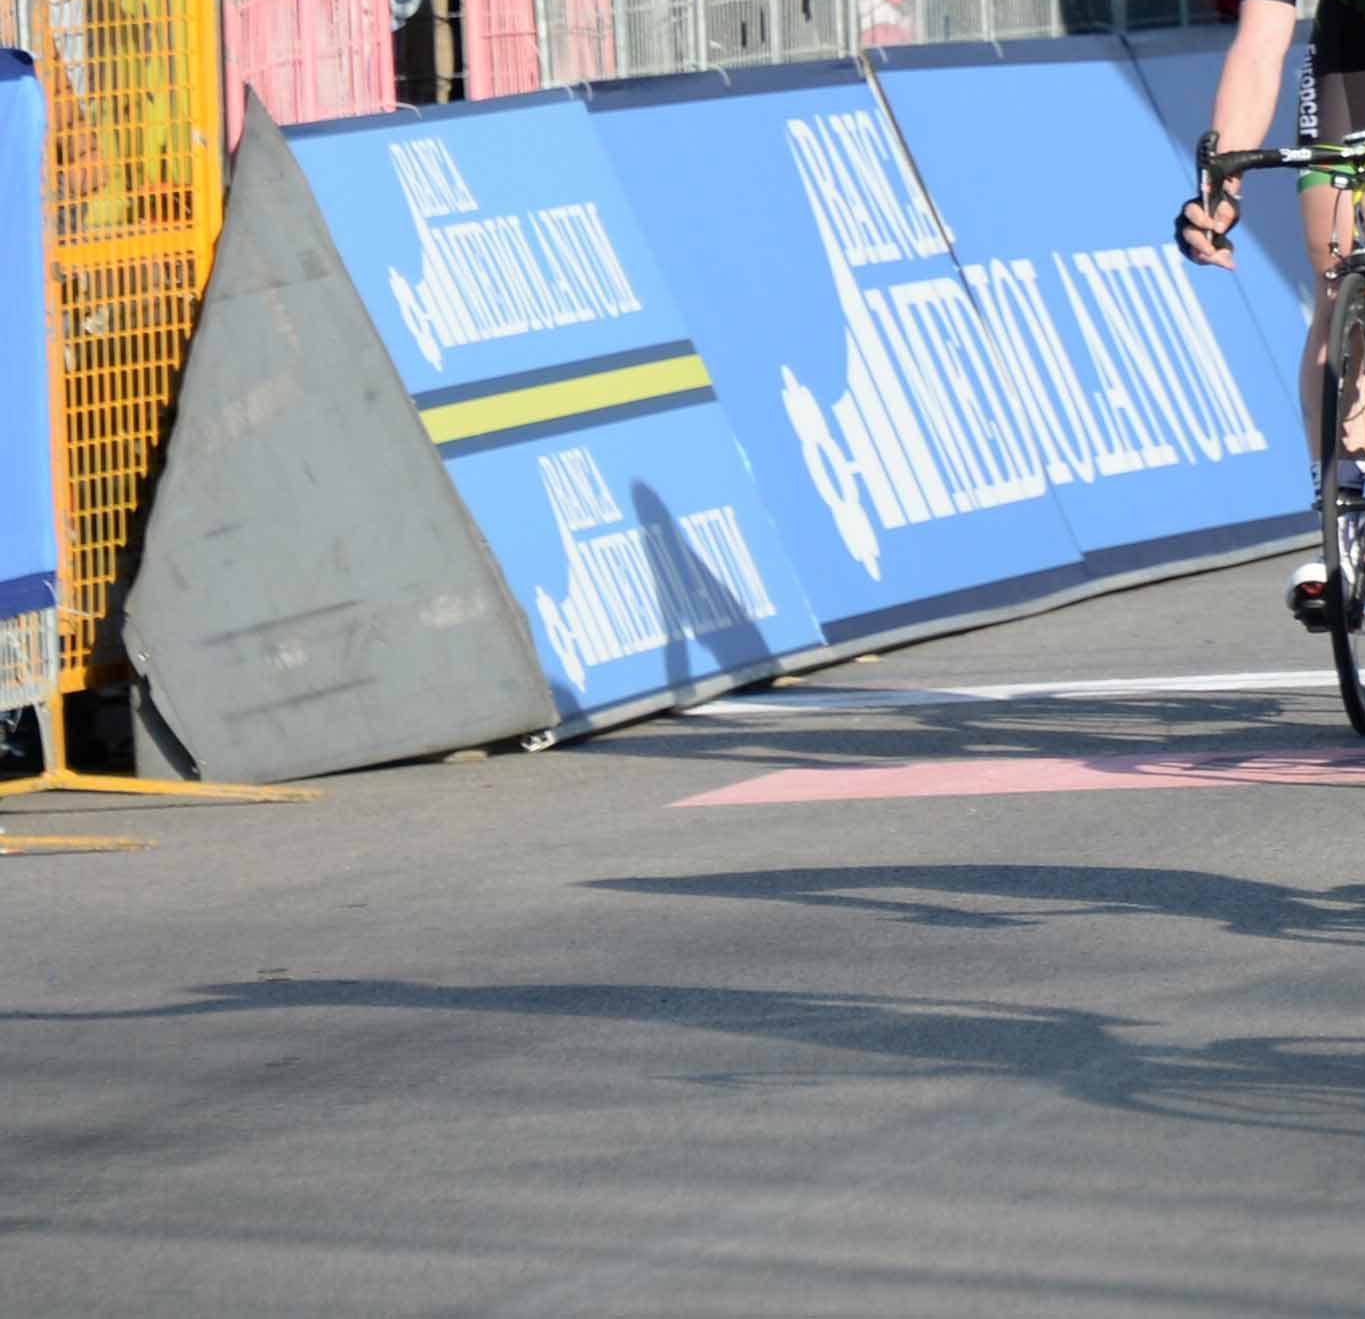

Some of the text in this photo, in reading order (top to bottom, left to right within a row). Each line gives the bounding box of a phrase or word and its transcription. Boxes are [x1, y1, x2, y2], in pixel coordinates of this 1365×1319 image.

[388, 137, 480, 222] BANCA
[788, 107, 958, 268] BANCA
[418, 200, 643, 350] MEDIOLANUM
[836, 242, 1269, 532] MEDIOLANUM
[536, 446, 624, 531] BANCA
[562, 504, 777, 667] MEDIOLANUM
